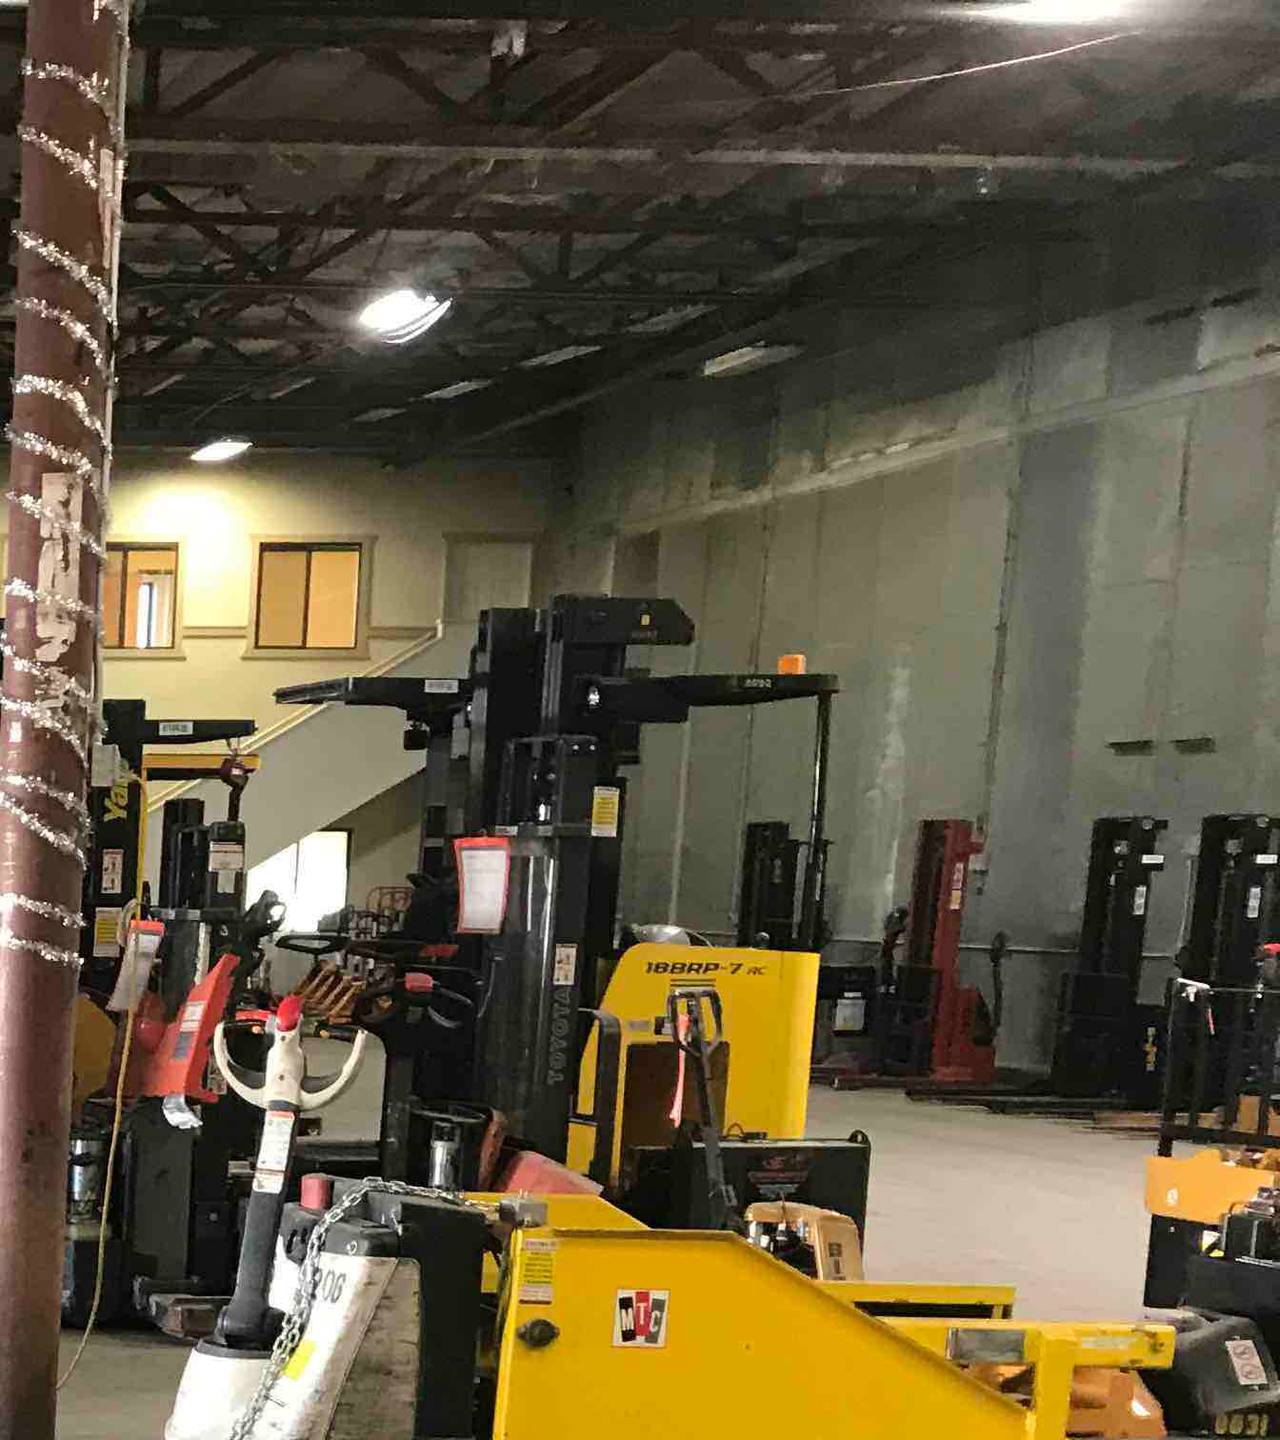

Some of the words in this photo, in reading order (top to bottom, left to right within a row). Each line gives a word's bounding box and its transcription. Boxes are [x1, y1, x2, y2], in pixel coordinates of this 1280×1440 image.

[103, 757, 131, 822] Ya
[547, 988, 571, 1086] TOYOTA
[621, 1301, 661, 1333] MTC
